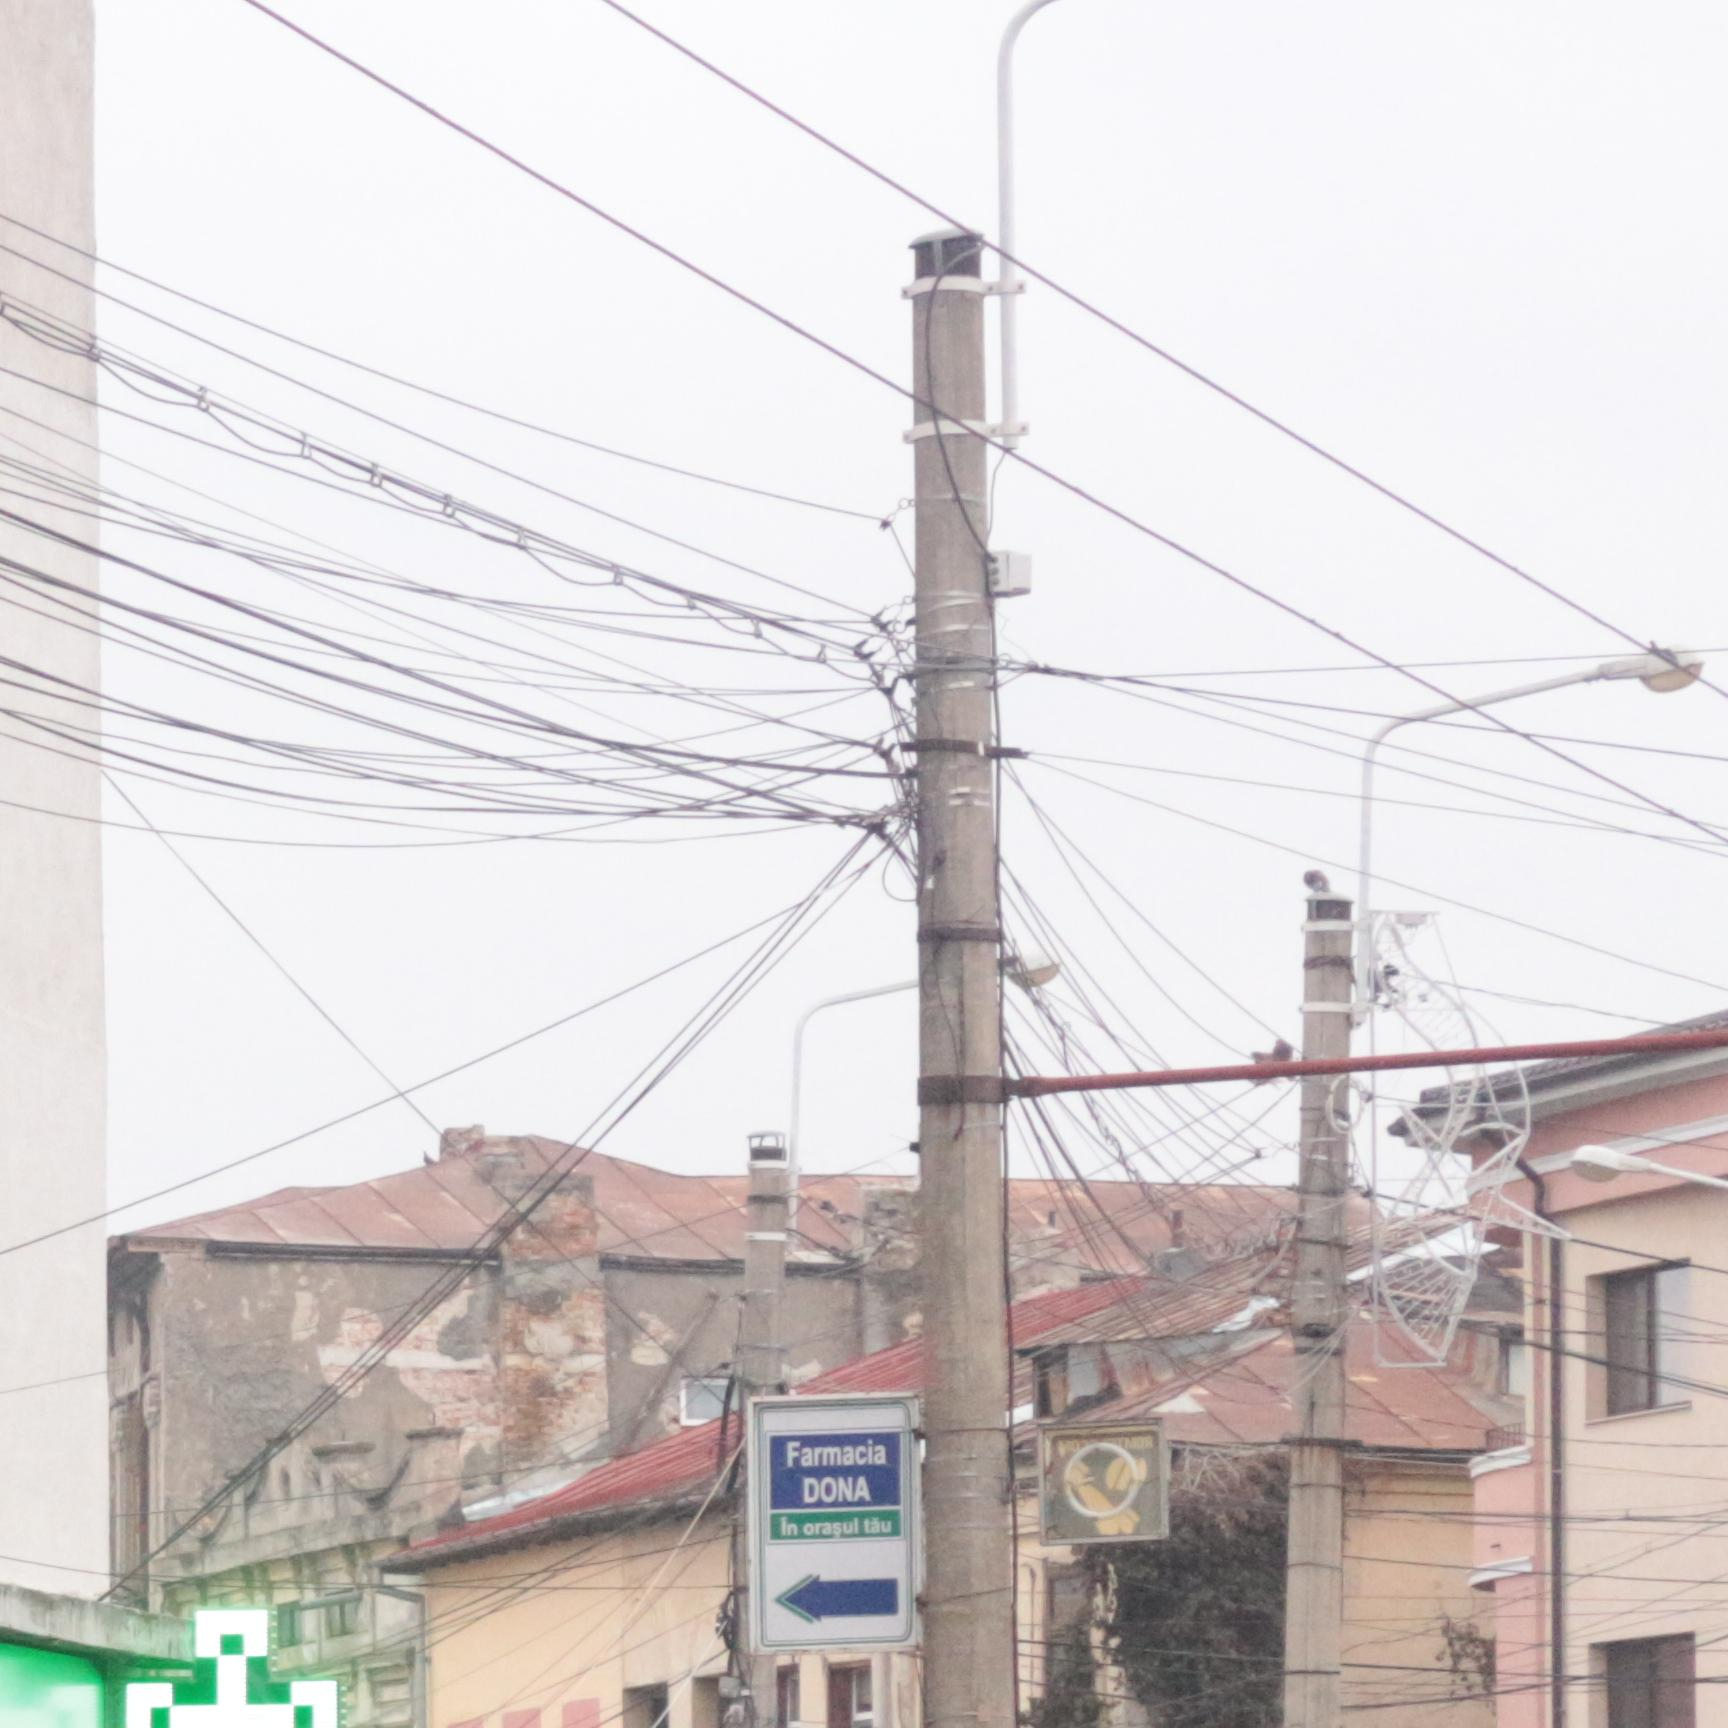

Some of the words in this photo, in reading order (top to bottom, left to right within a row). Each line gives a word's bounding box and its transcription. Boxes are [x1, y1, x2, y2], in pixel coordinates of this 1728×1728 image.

[787, 1438, 887, 1468] Farmacia
[802, 1476, 873, 1505] DONA
[864, 1517, 893, 1535] tău
